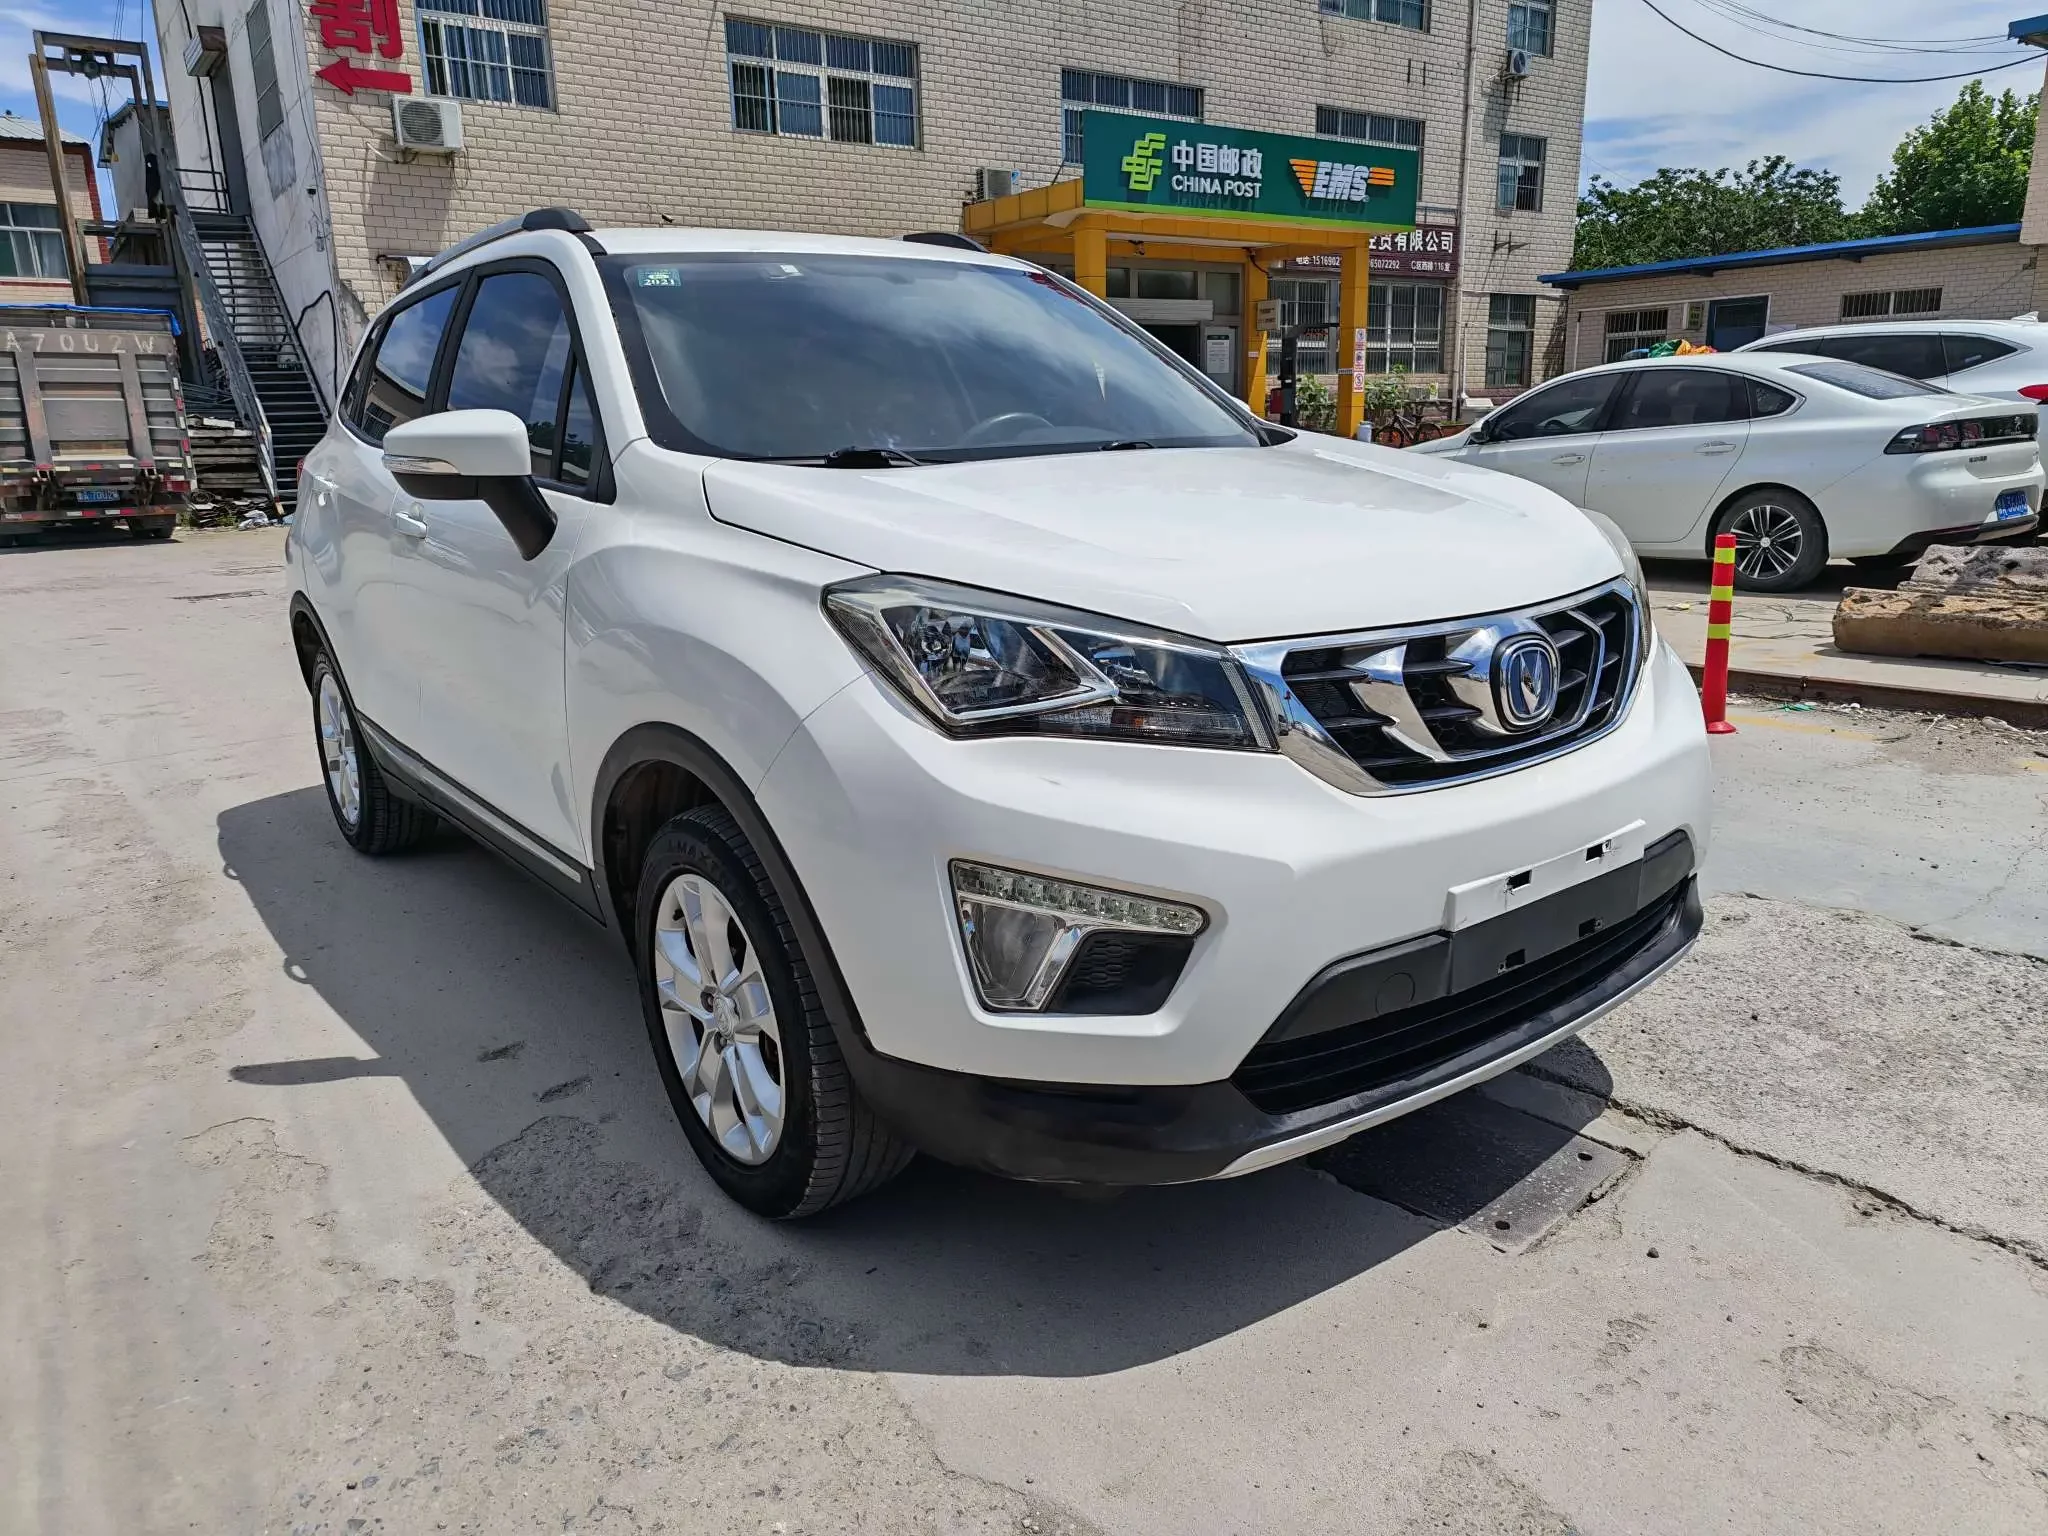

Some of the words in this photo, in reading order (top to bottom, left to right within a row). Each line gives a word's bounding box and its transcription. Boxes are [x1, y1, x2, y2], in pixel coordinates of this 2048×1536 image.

[1172, 140, 1262, 179] 中国邮政
[1172, 175, 1222, 194] CHINA
[1223, 180, 1262, 198] POST
[1312, 162, 1368, 201] EMS
